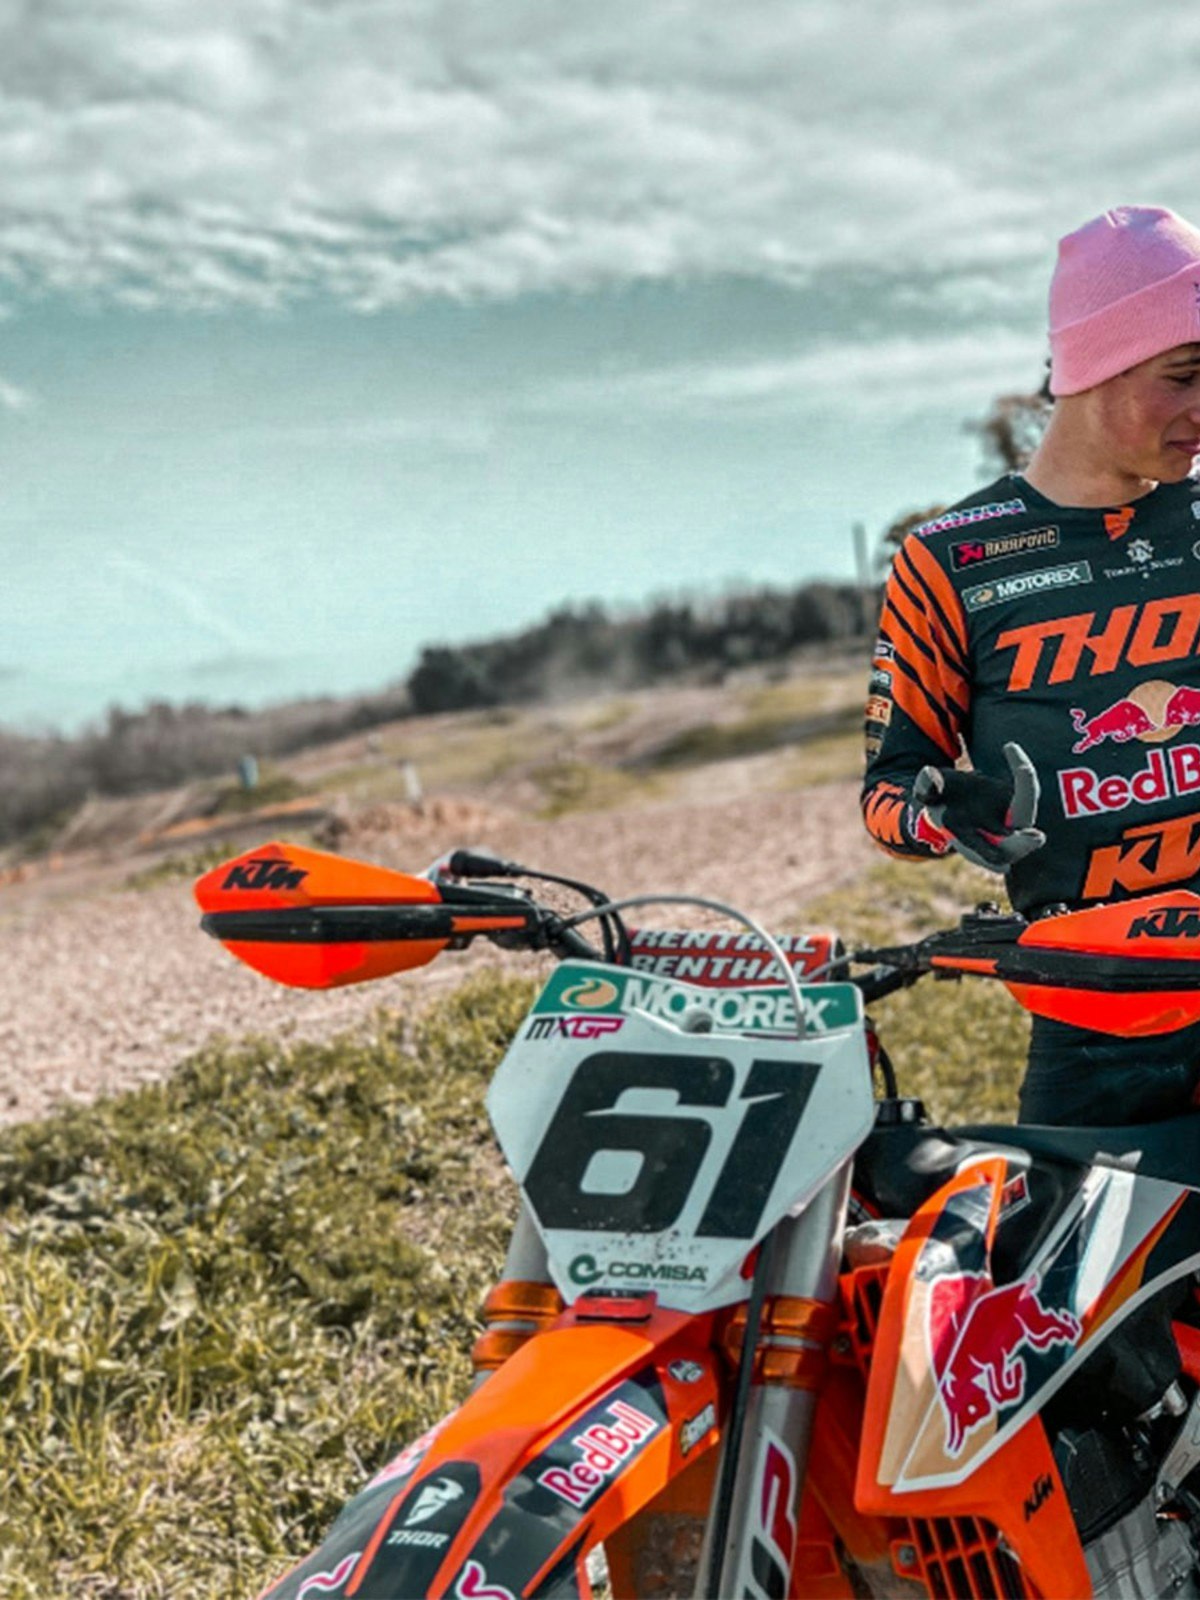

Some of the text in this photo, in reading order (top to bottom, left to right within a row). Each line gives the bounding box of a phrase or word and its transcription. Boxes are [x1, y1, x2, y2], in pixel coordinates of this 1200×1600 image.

[996, 566, 1081, 598] MOTOREX
[1058, 750, 1169, 819] Red
[221, 858, 310, 891] KTM
[630, 927, 817, 954] RENTHAL
[630, 953, 810, 983] RENTHAL
[620, 977, 834, 1032] MOTOREX
[525, 1015, 625, 1041] MXGP
[523, 1050, 822, 1240] 61
[608, 1261, 707, 1283] COMISA
[538, 1436, 614, 1508] Red
[588, 1400, 659, 1463] Bull
[385, 1529, 450, 1549] THOR
